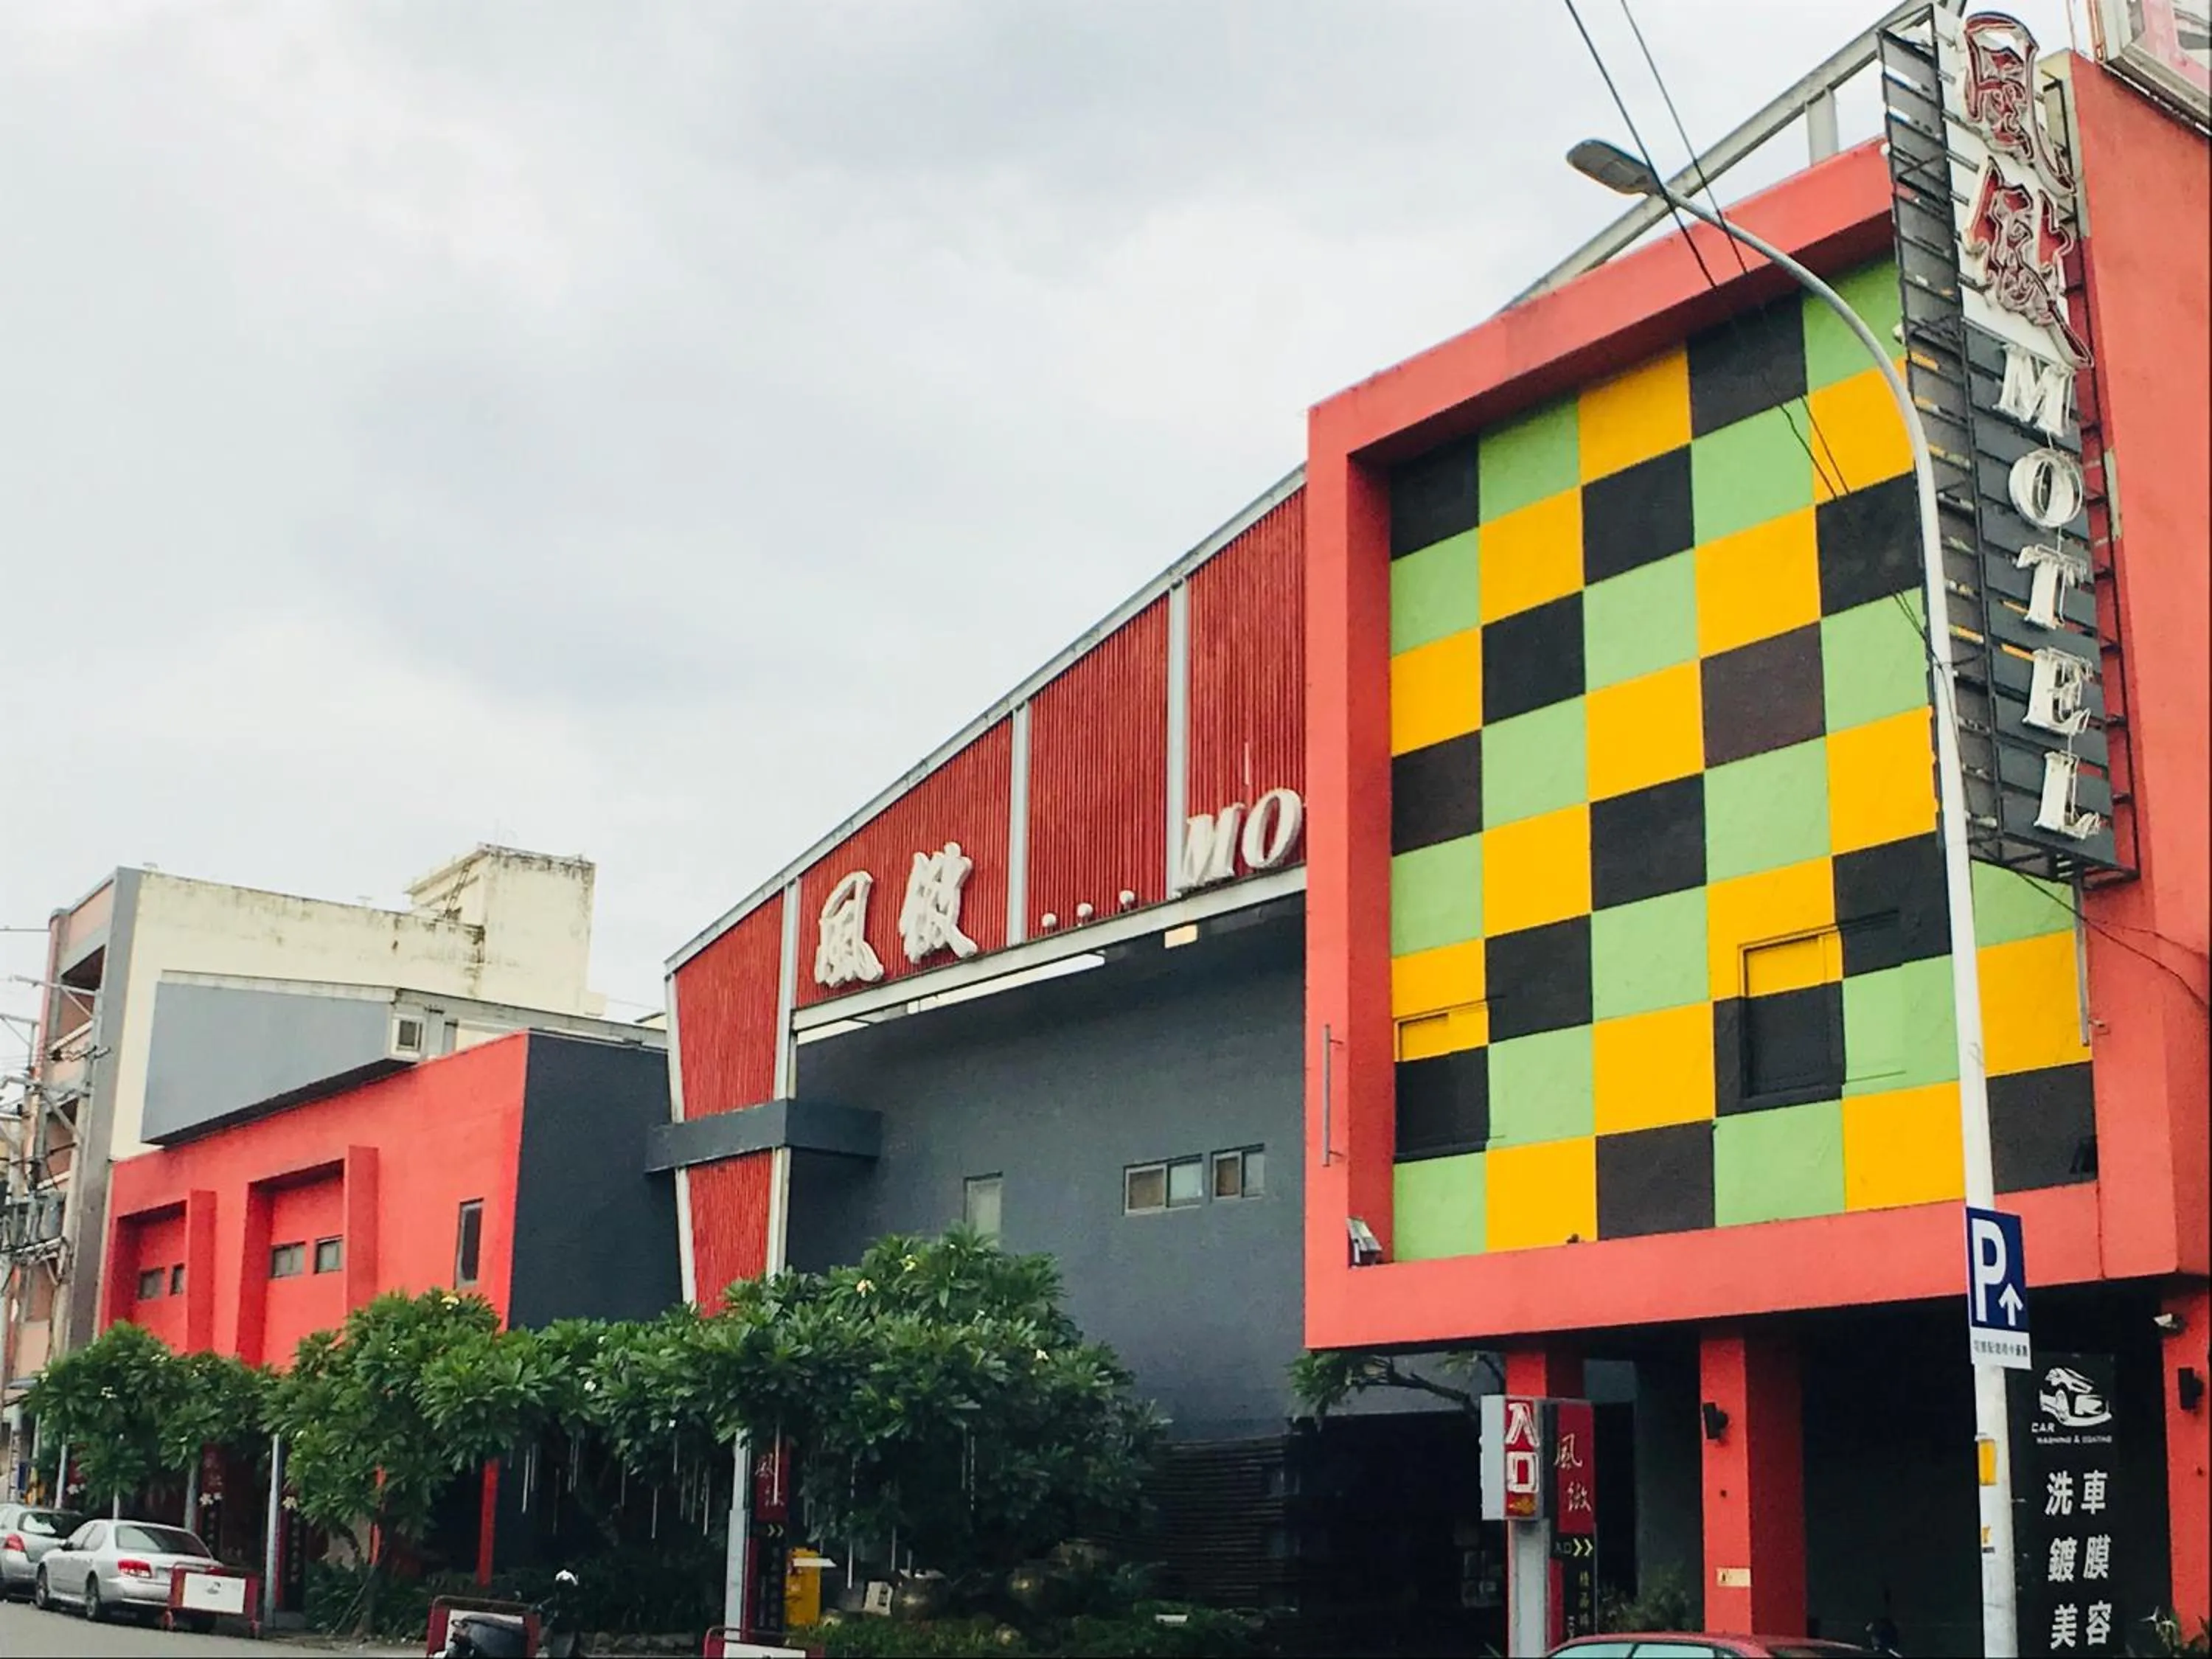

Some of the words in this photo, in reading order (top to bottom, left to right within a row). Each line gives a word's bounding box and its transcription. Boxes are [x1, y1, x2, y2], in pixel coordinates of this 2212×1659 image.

[1992, 342, 2101, 841] MOTEL
[1972, 1217, 2007, 1322] P
[1505, 1402, 1540, 1494] 入口
[2031, 1422, 2055, 1433] CAR
[2045, 1470, 2108, 1515] 洗車
[2048, 1534, 2112, 1582] 鍍膜
[2050, 1600, 2112, 1650] 美容
